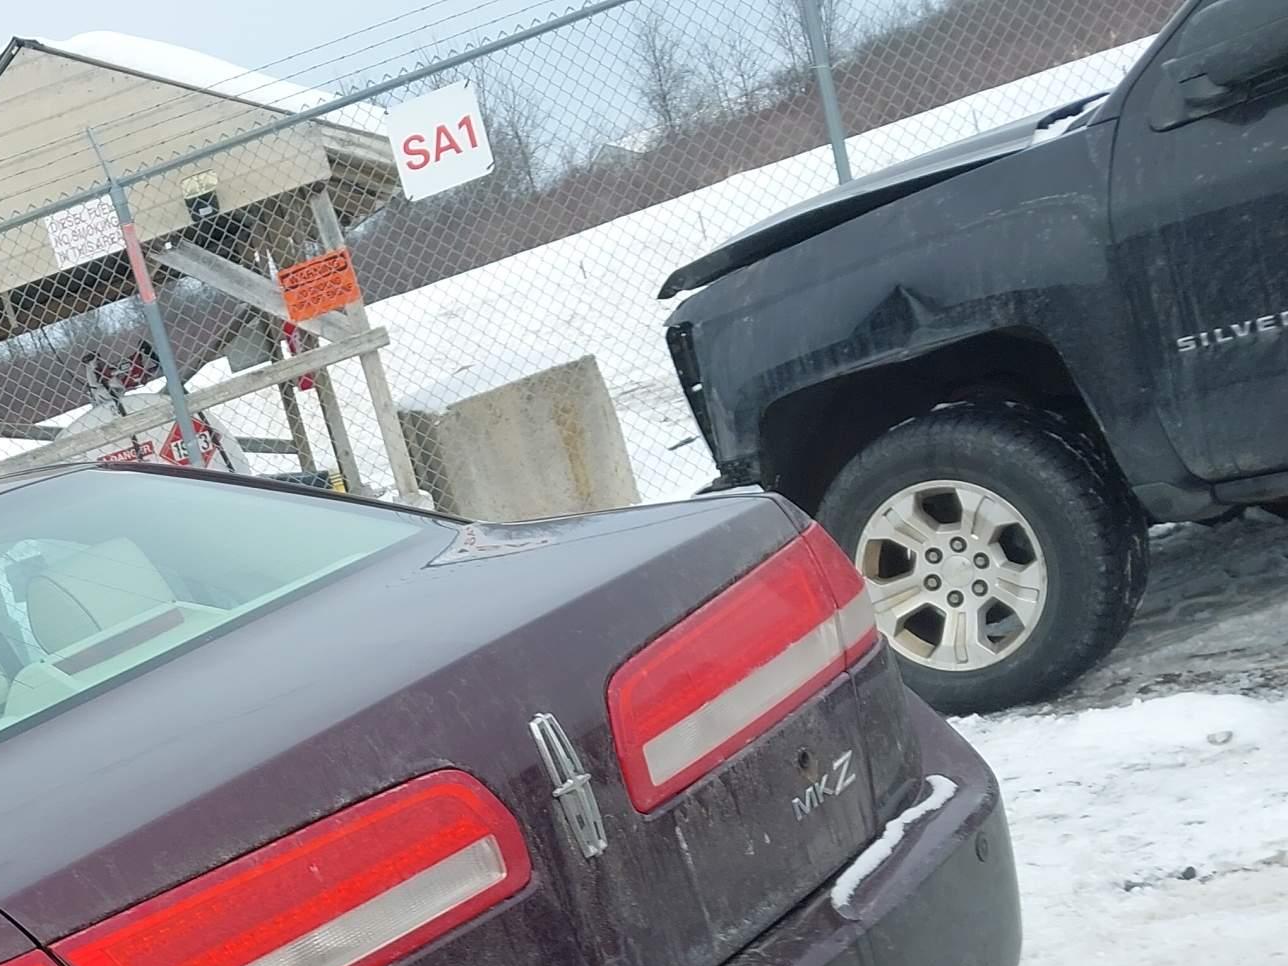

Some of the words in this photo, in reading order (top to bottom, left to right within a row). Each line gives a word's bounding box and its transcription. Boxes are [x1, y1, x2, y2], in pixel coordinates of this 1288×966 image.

[403, 114, 479, 170] SA1
[110, 444, 153, 461] DANGR
[791, 750, 856, 821] MKZ
